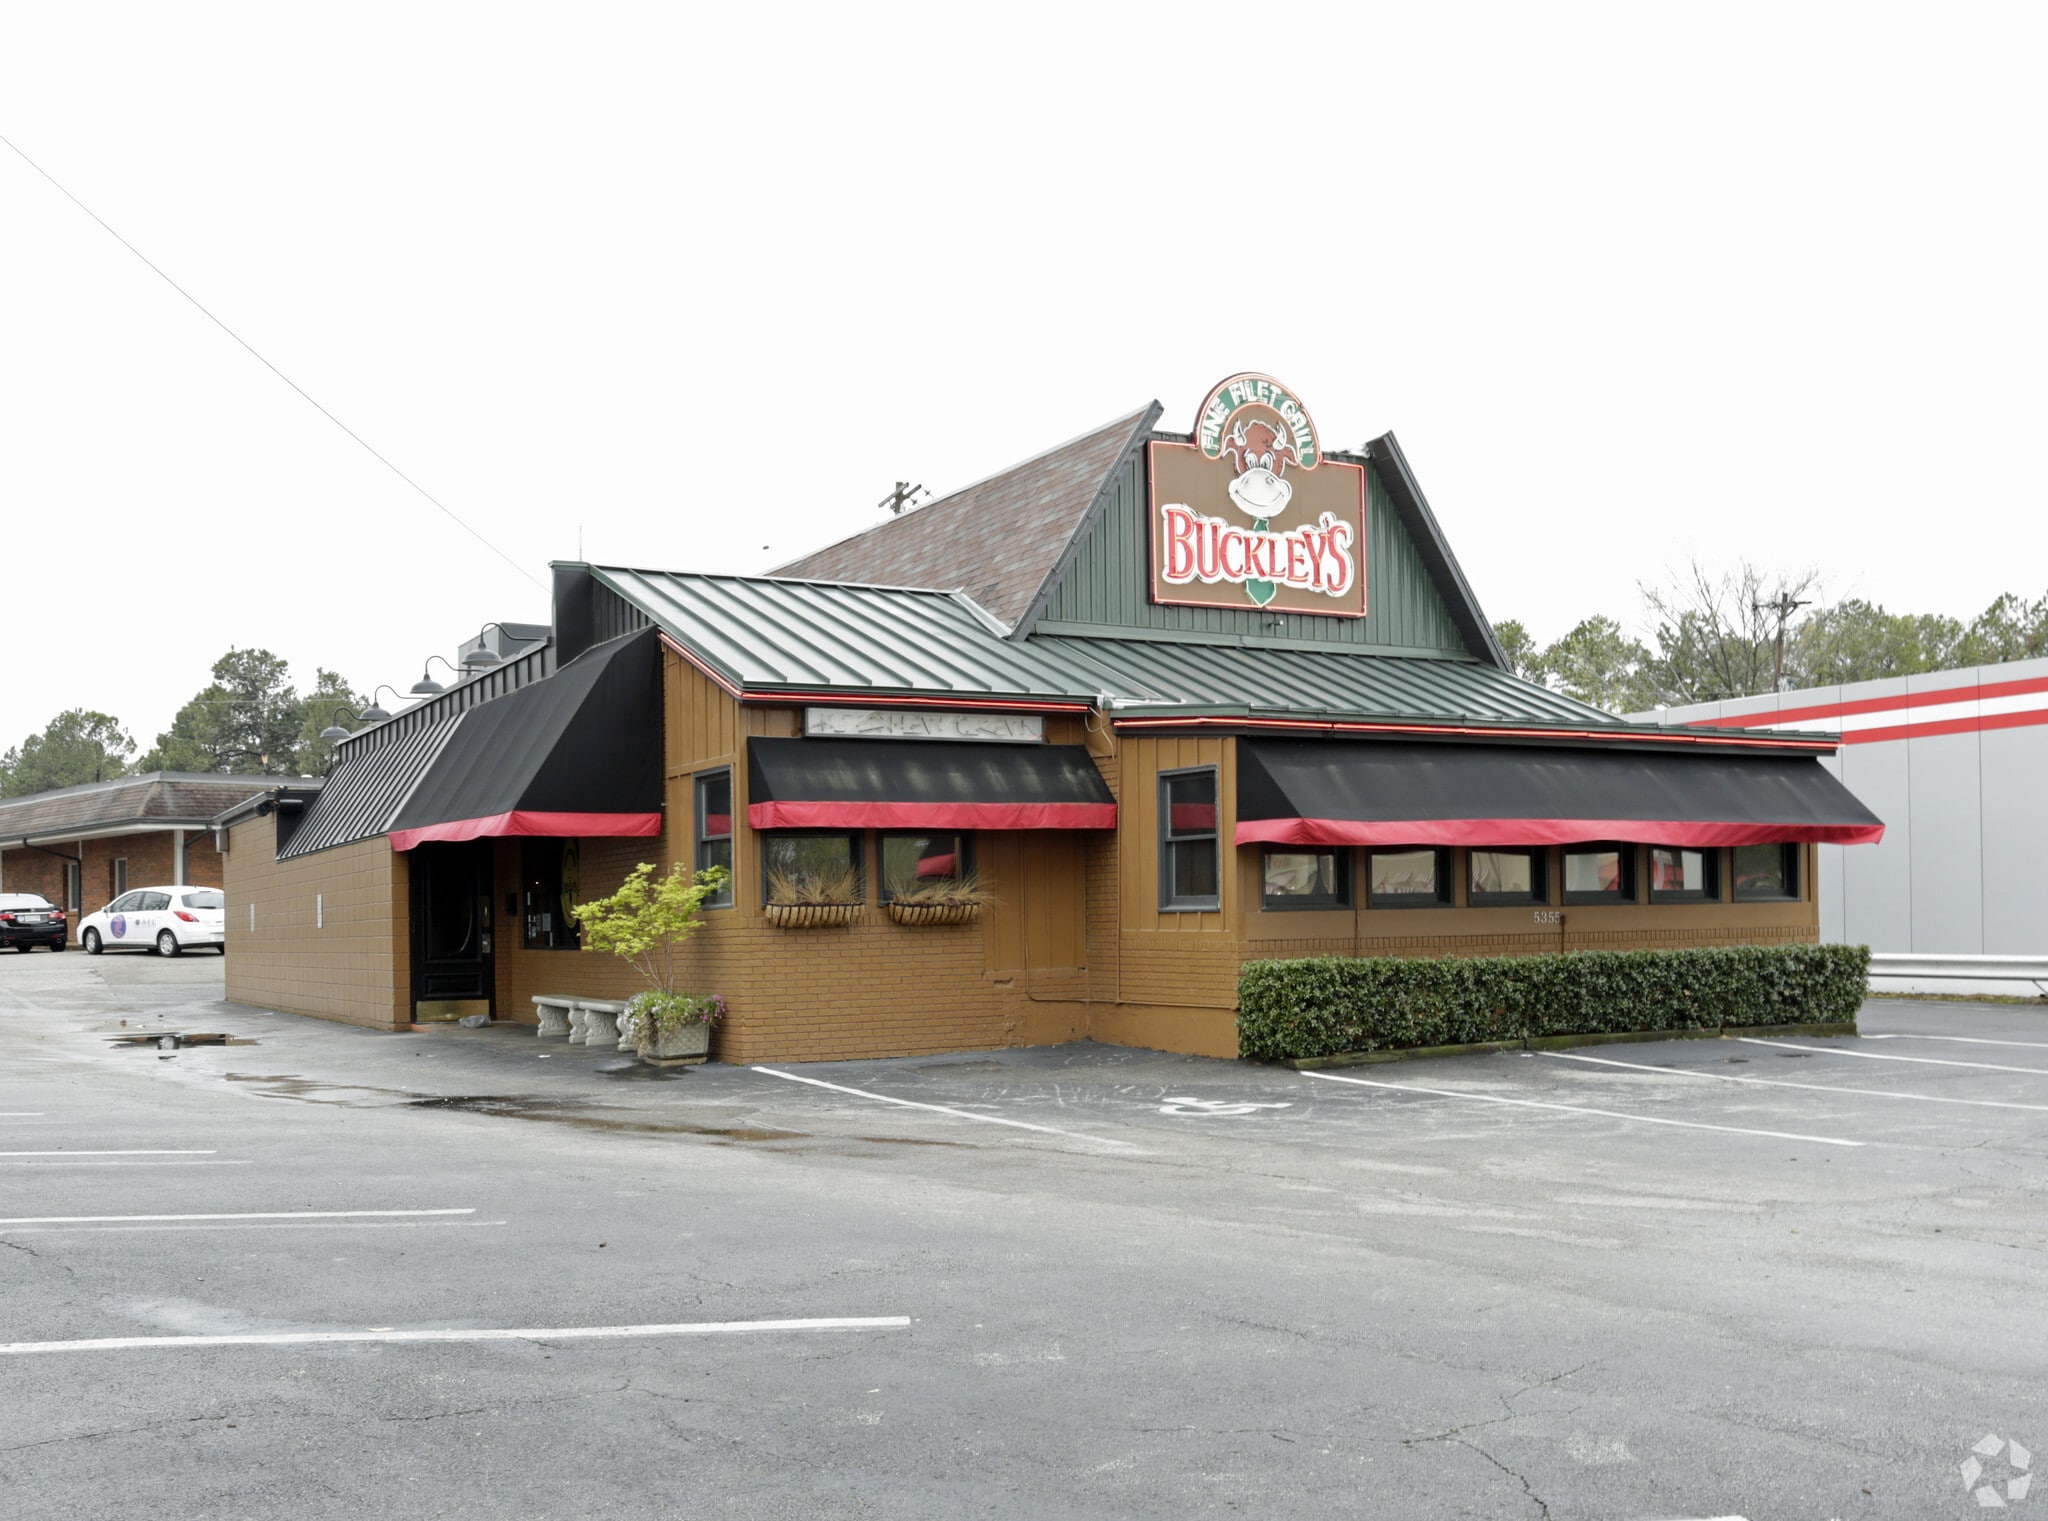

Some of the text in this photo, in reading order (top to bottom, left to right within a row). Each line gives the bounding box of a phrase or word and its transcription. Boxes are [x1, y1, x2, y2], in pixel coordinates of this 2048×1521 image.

[1201, 380, 1314, 460] FINE FILET GRILL
[1166, 508, 1348, 593] BUCKLEY'S
[1533, 911, 1561, 923] 5355
